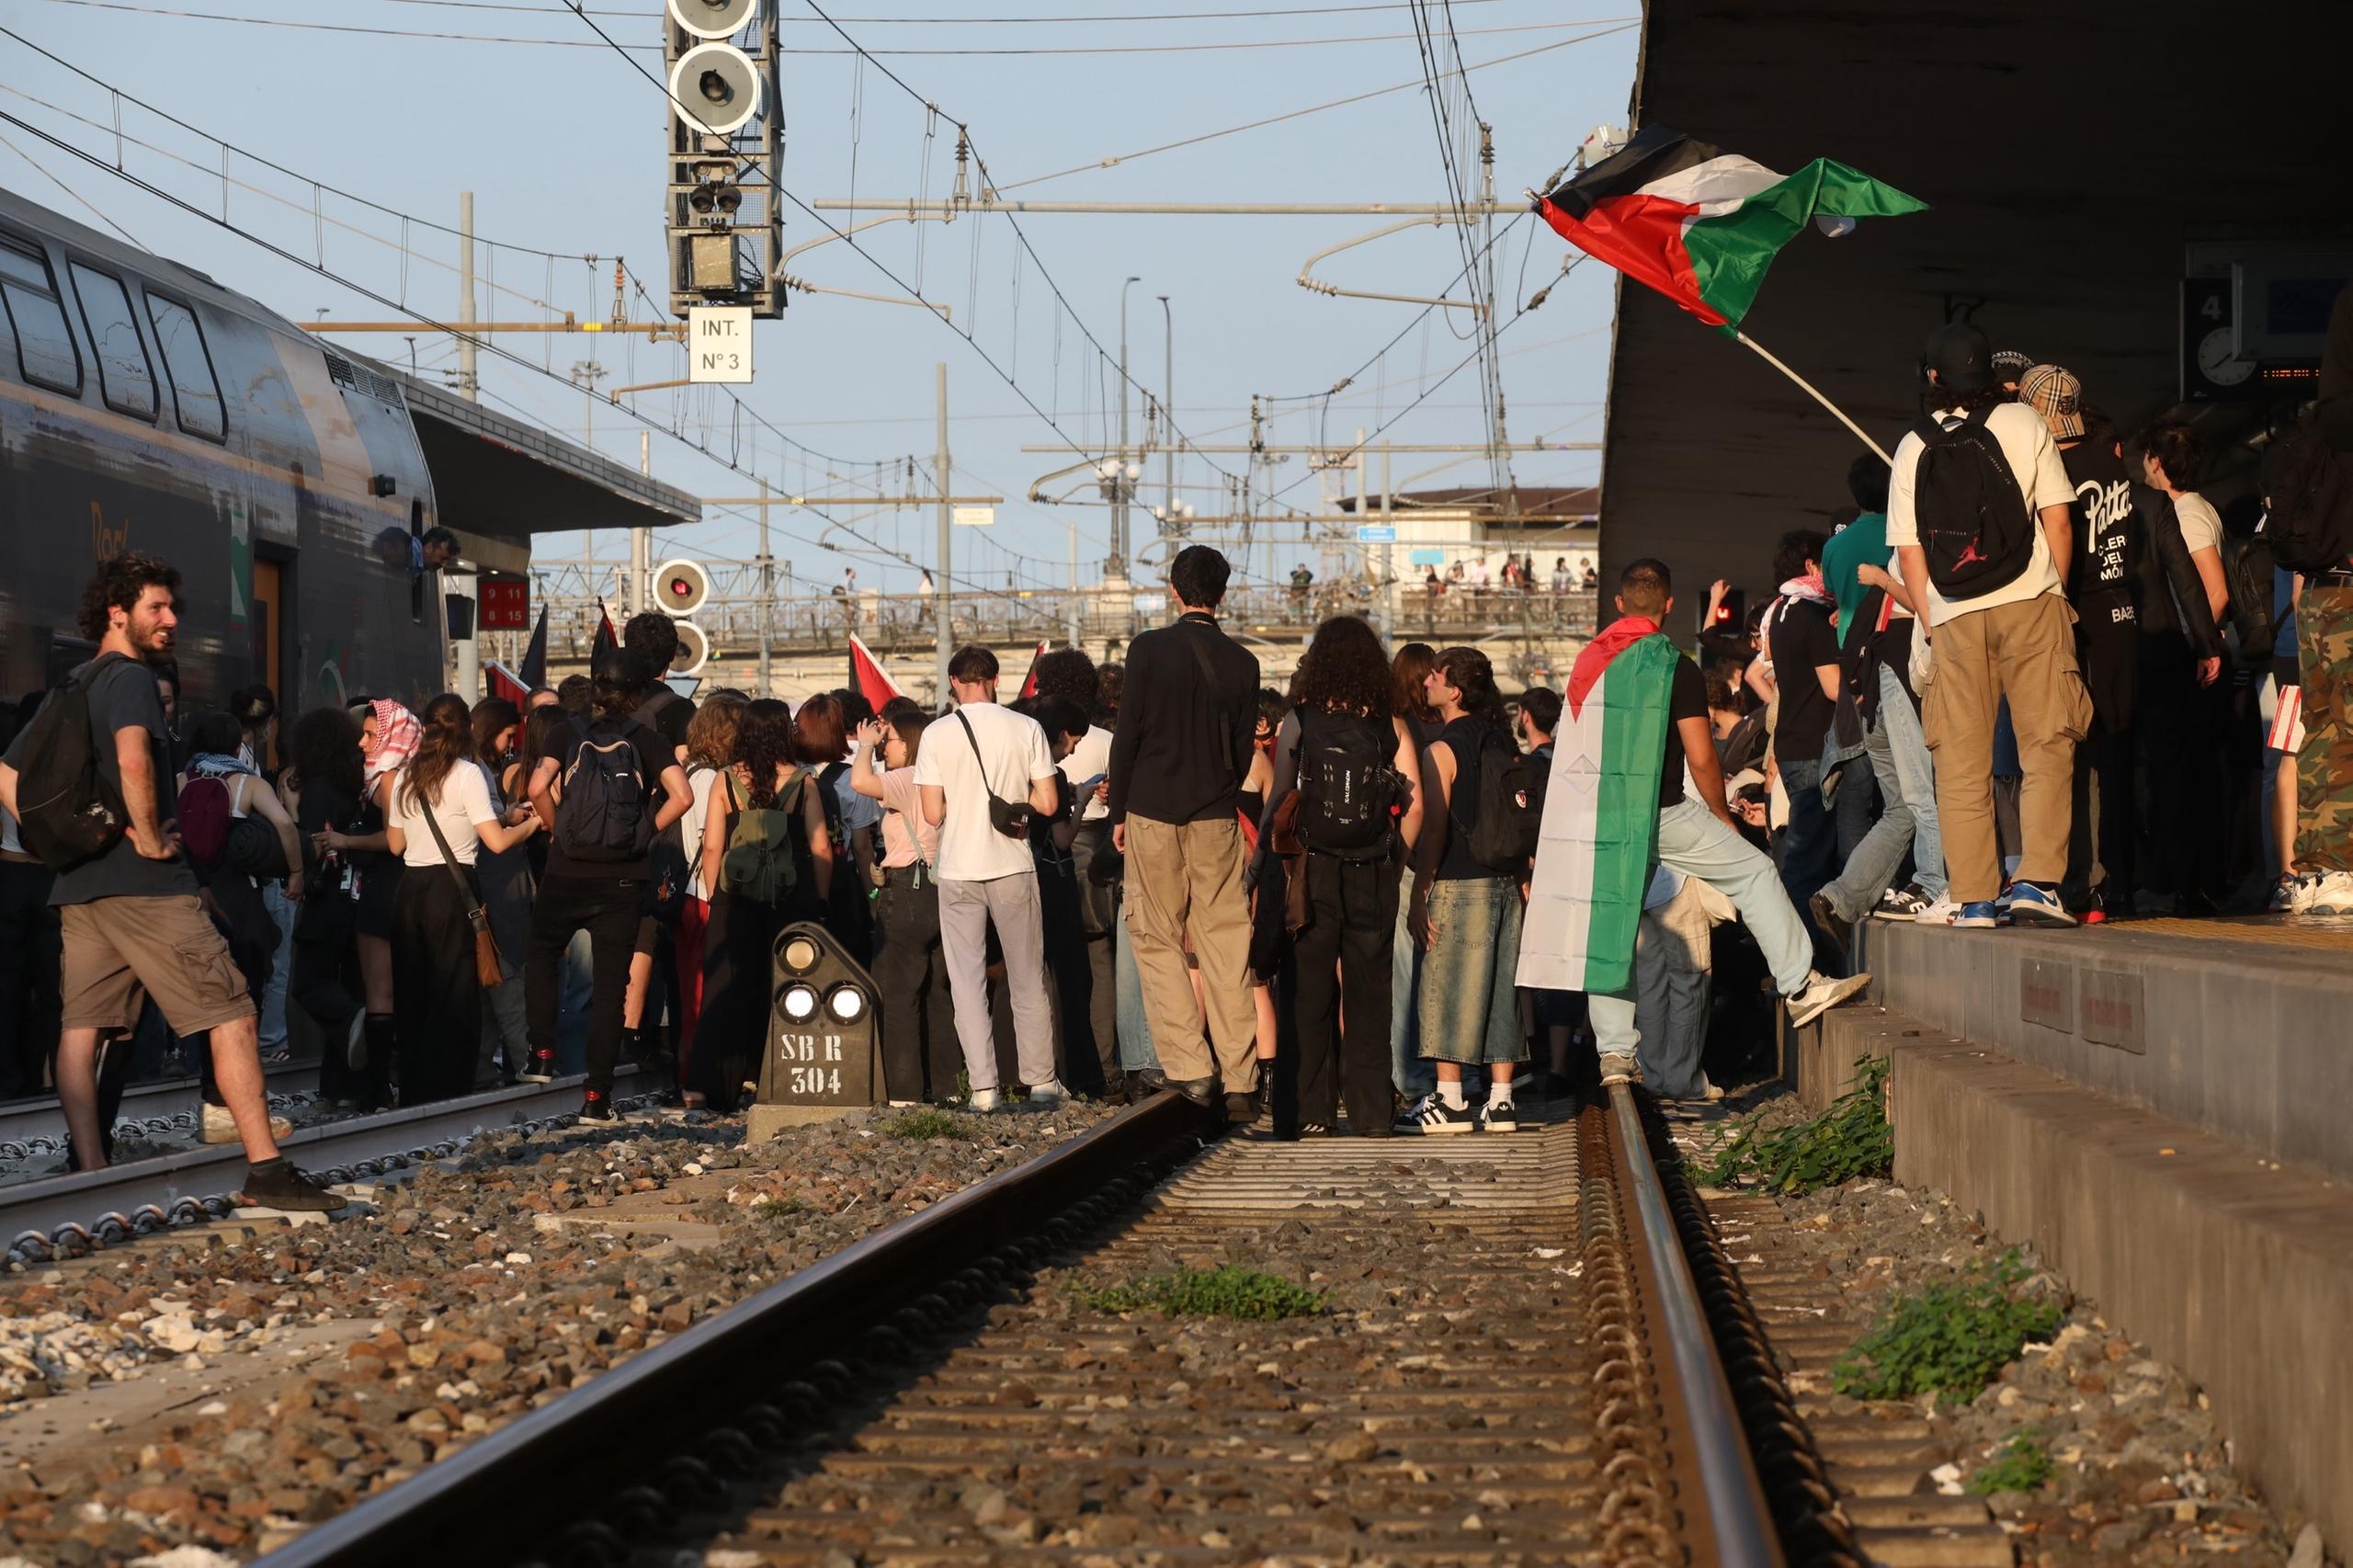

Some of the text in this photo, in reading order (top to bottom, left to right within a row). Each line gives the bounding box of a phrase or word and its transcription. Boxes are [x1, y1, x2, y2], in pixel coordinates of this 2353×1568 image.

[2201, 295, 2222, 320] 4
[702, 320, 738, 336] INT.
[728, 353, 739, 369] 3
[2075, 479, 2133, 553] Patta
[488, 588, 520, 598] 9 11
[488, 610, 522, 621] 8 15
[790, 1067, 841, 1094] 304
